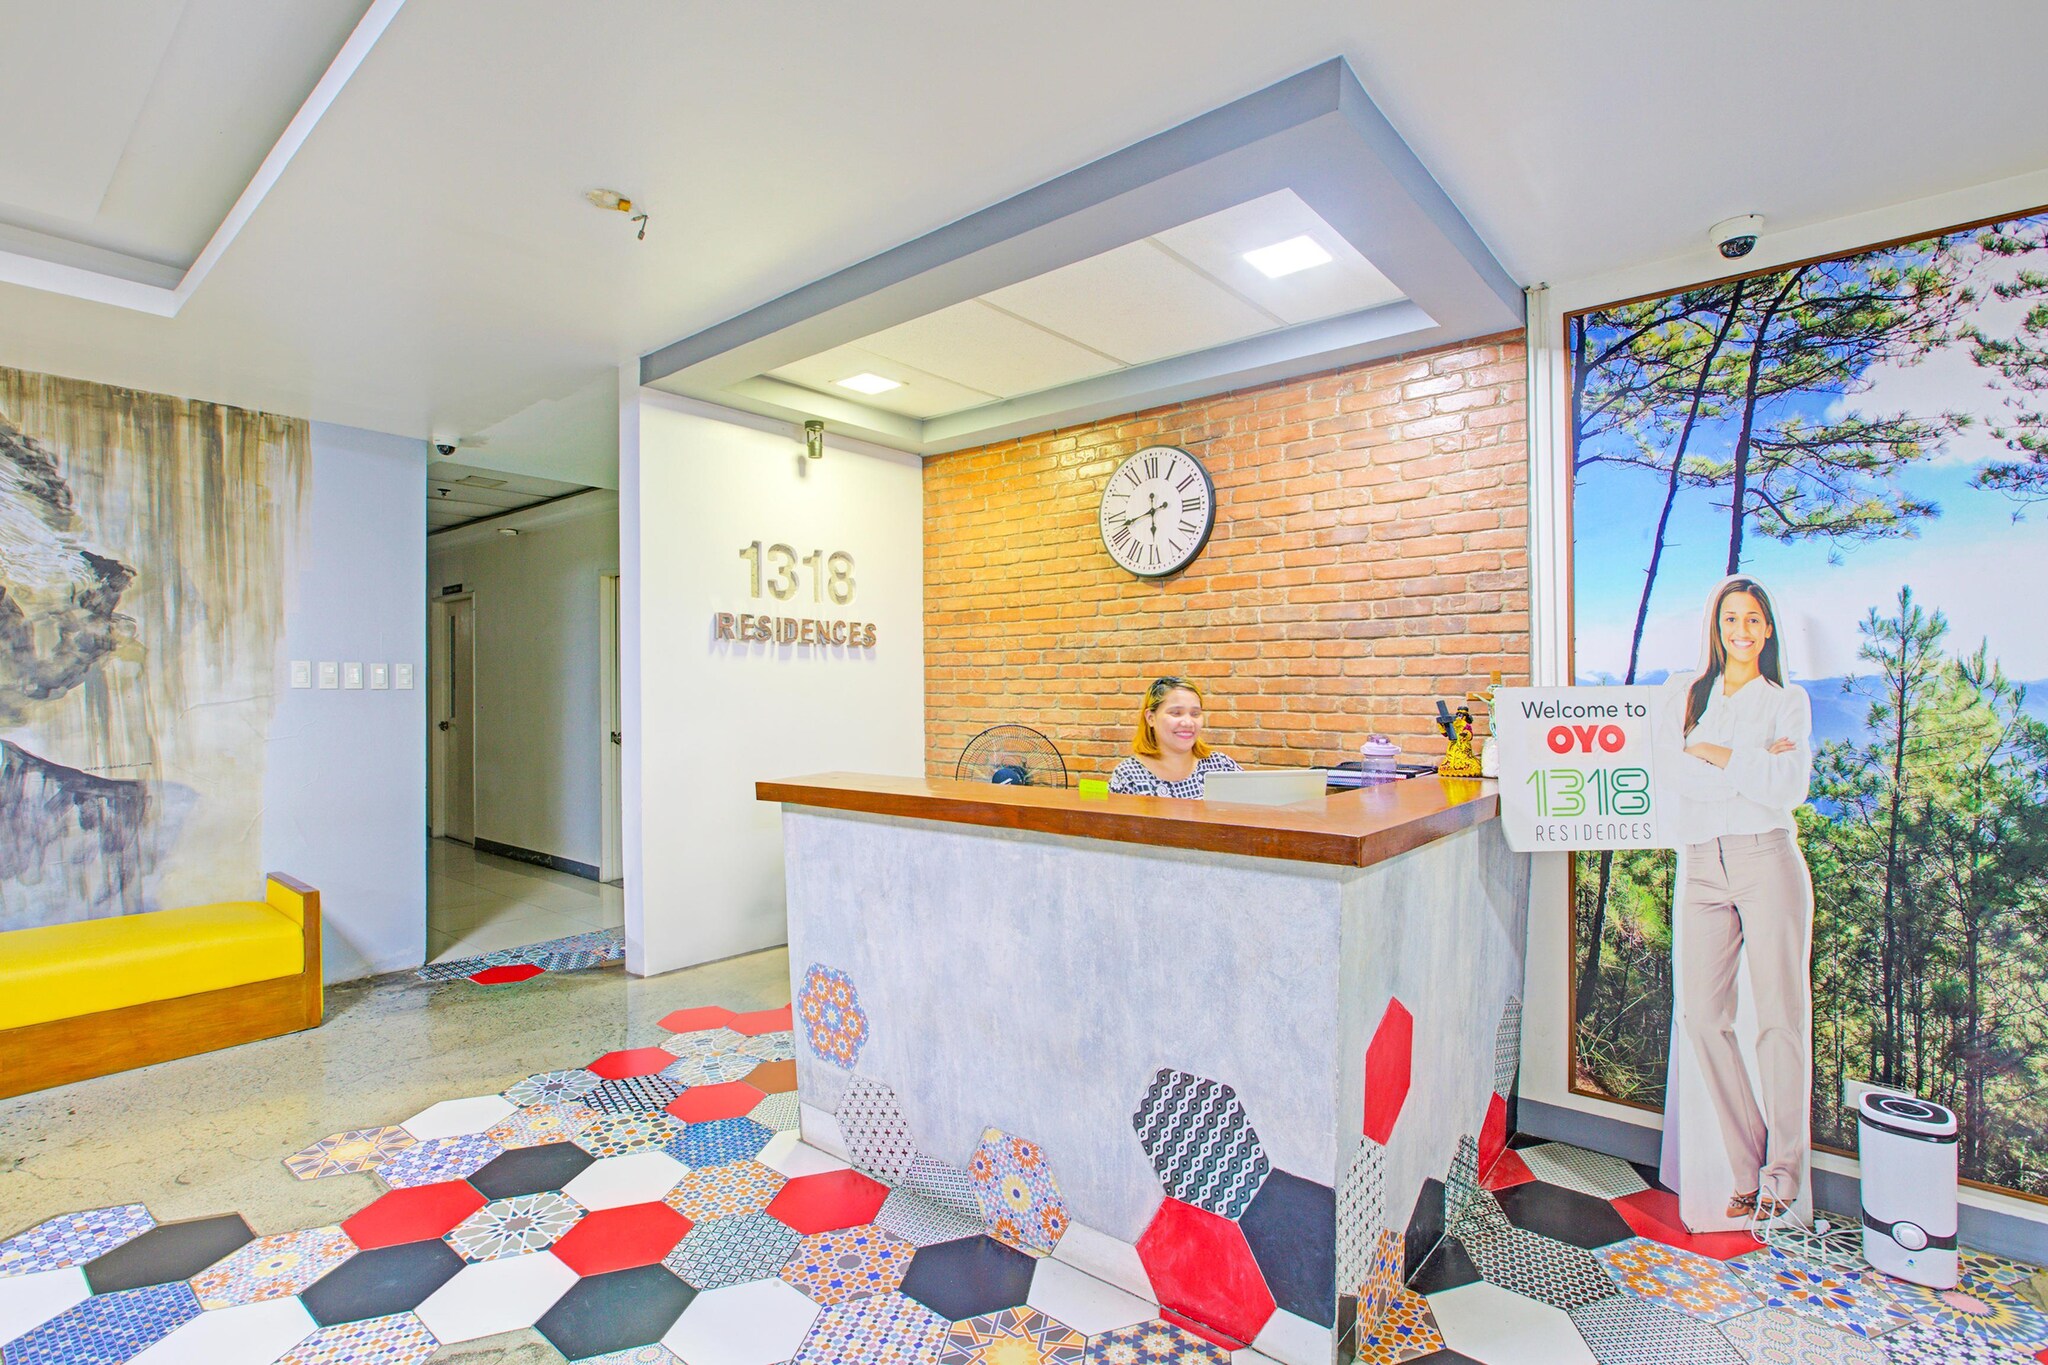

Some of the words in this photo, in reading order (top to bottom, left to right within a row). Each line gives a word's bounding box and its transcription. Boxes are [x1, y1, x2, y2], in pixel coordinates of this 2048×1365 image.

[739, 540, 857, 606] 1318
[714, 612, 877, 648] RESIDENCES
[1521, 700, 1619, 719] Welcome
[1625, 702, 1647, 718] to
[1547, 724, 1626, 755] OYO
[1526, 767, 1651, 817] 1318
[1536, 822, 1652, 842] RESIDENCES
